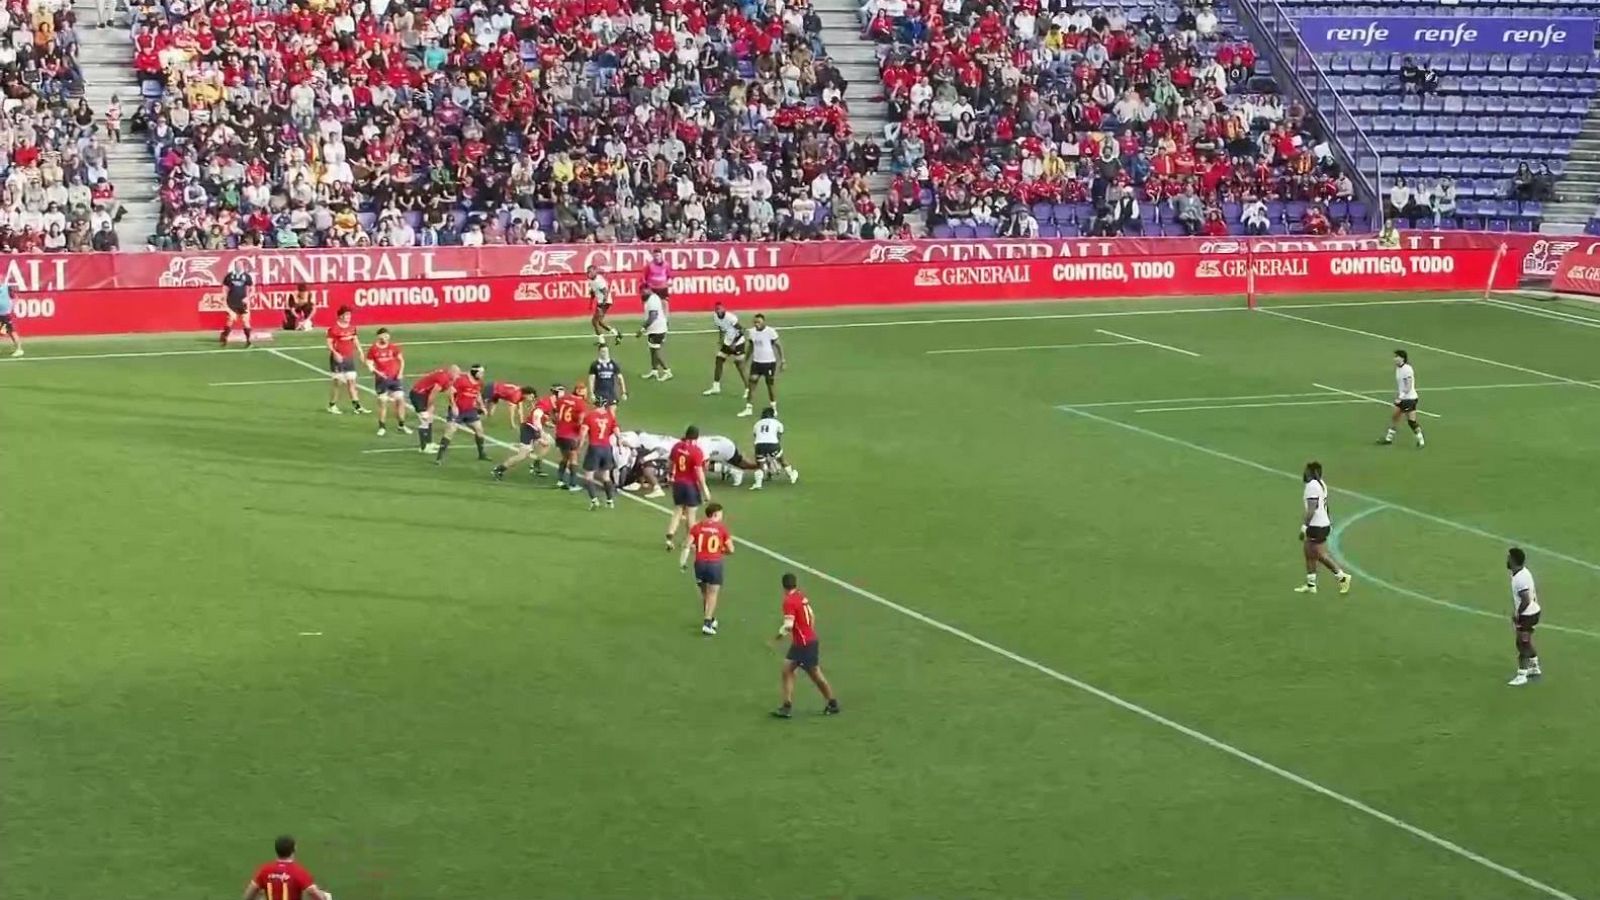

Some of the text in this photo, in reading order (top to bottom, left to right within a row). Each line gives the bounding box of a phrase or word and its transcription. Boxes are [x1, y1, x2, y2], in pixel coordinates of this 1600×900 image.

[1327, 22, 1389, 46] renfe
[1414, 23, 1478, 47] renfe
[1502, 24, 1567, 48] renfe
[942, 260, 1175, 285] GENERALI CONTIGO, TODO
[1222, 254, 1454, 278] GENERALI CONTIGO, TODO
[247, 284, 491, 311] ENELI CONTIGO, TODO
[543, 272, 790, 300] GENEALI ONTIGO, TODO
[14, 298, 55, 318] ODO
[698, 533, 721, 554] 10
